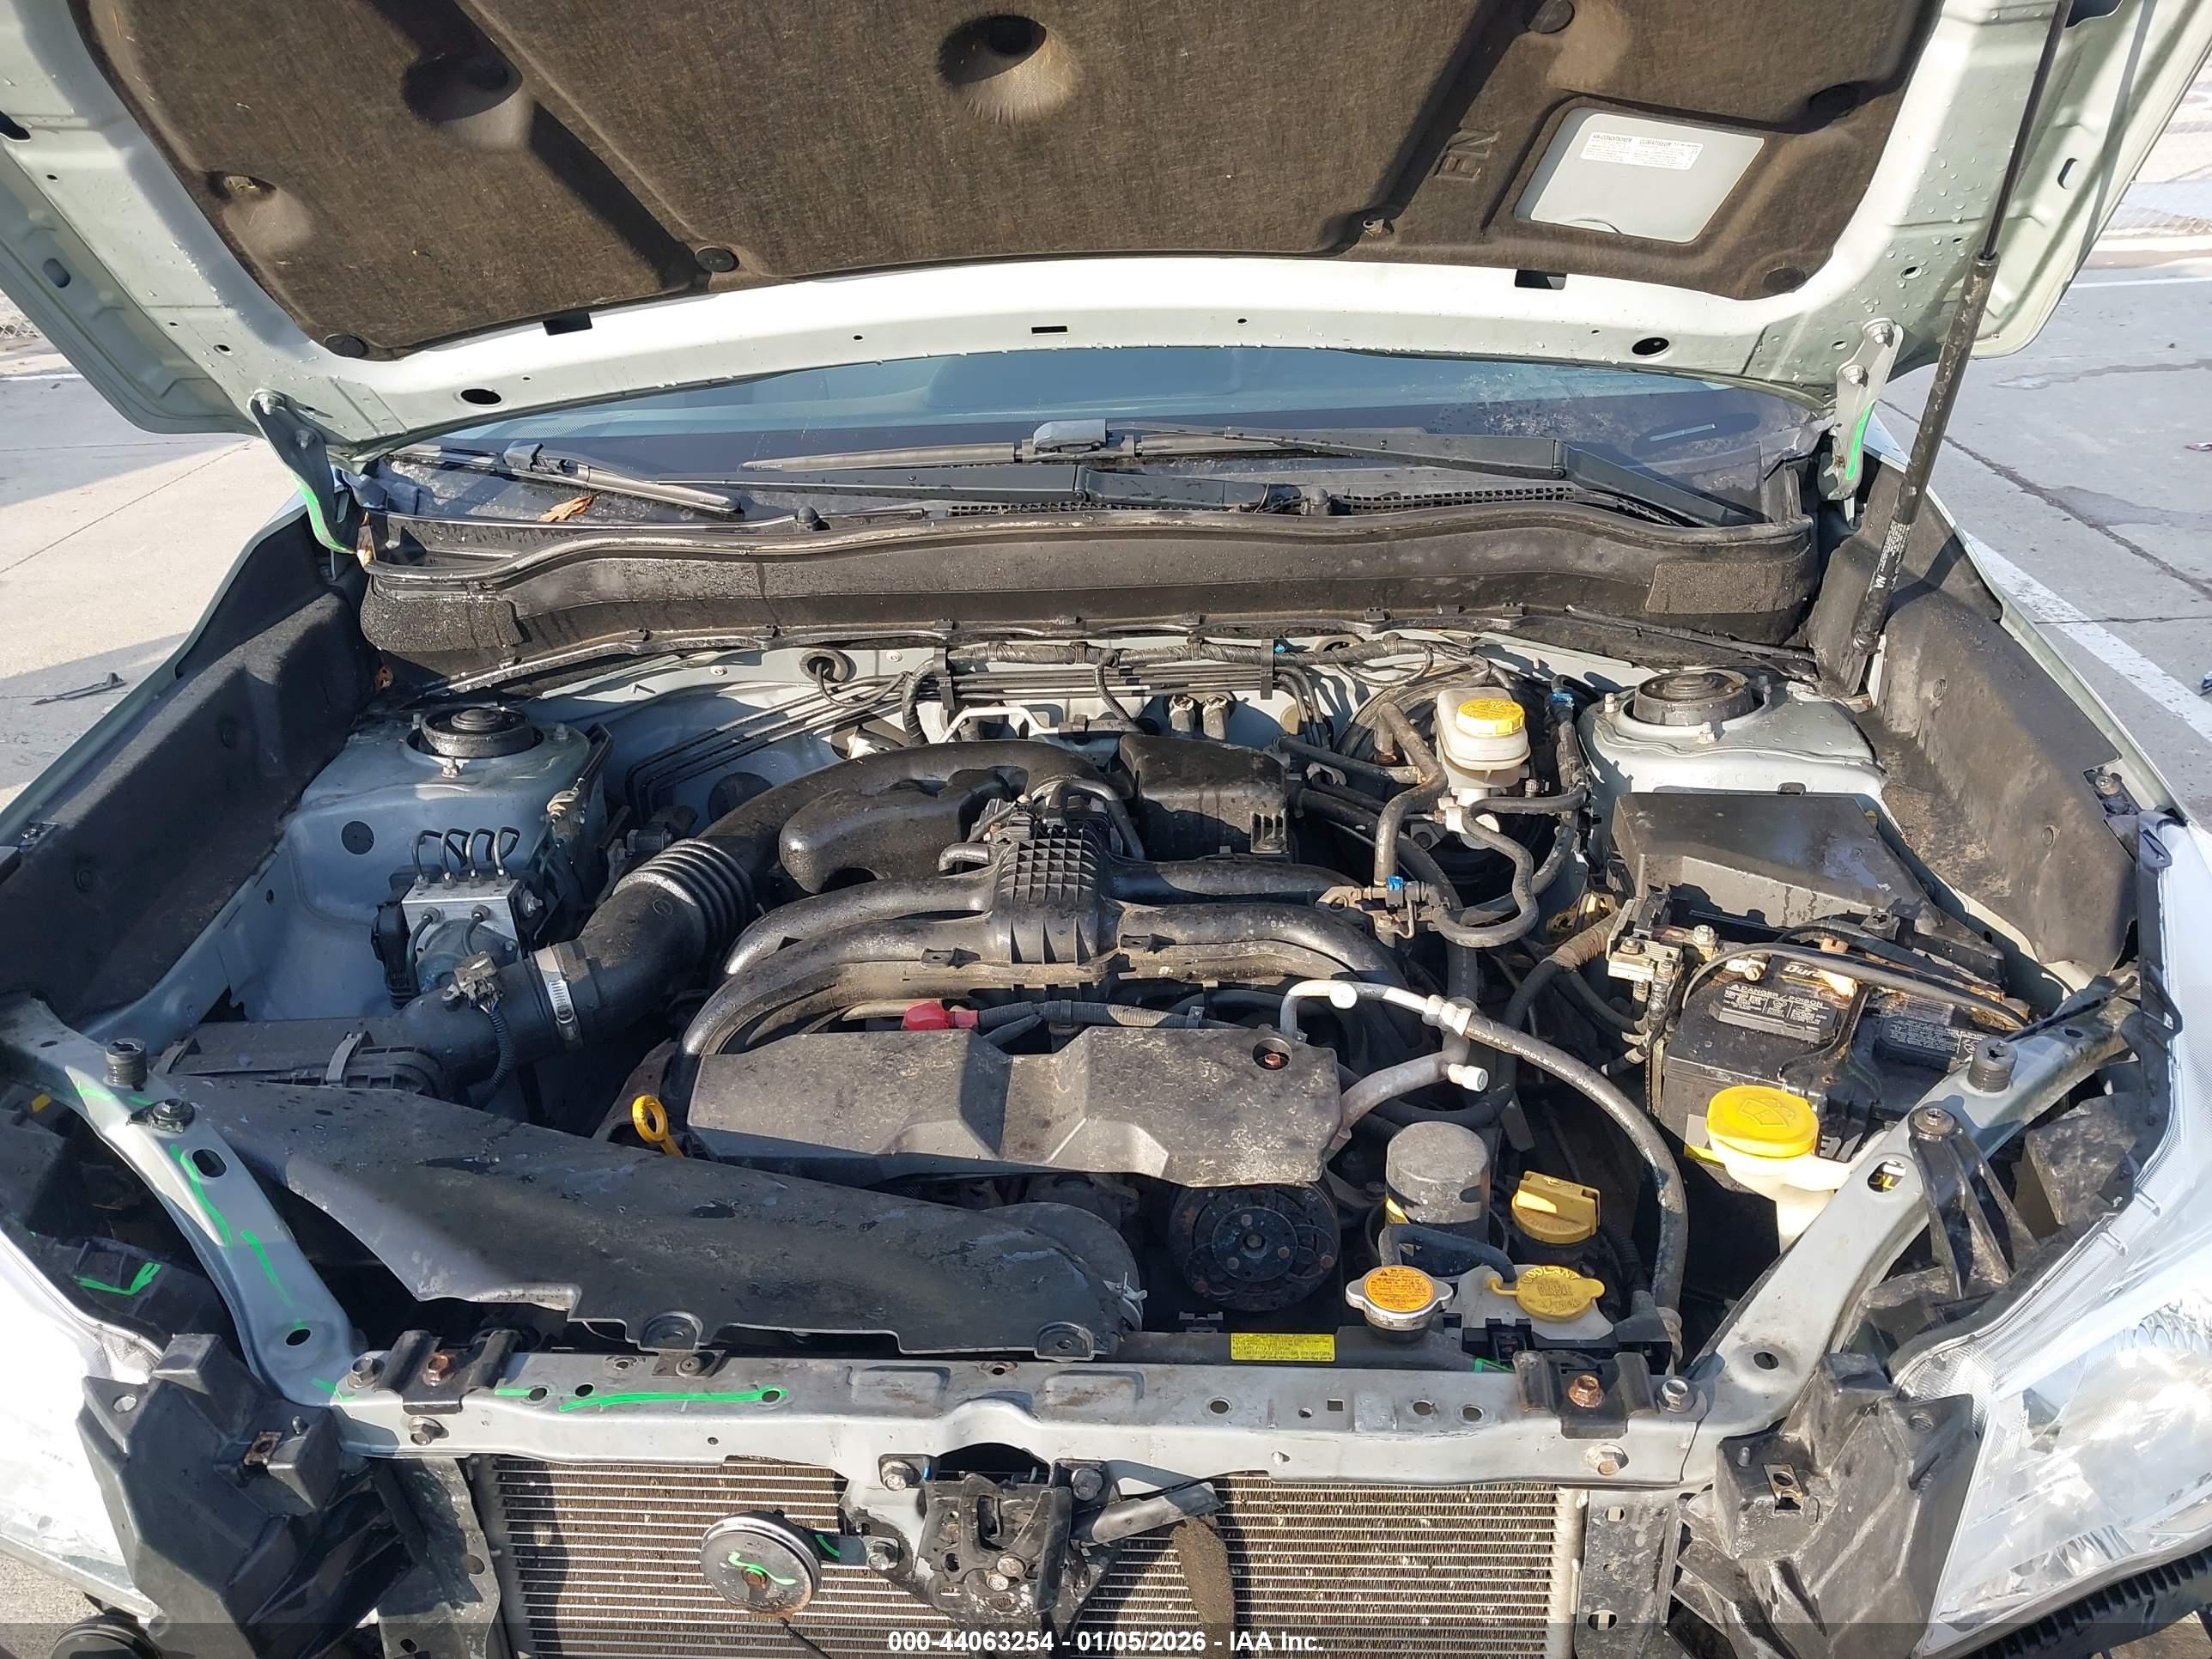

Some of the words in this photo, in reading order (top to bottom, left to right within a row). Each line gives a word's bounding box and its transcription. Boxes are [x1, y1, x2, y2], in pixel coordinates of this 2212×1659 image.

[1741, 985, 1779, 998] DANGER
[1789, 995, 1823, 1007] POISON
[1521, 1266, 1581, 1285] COOLANT
